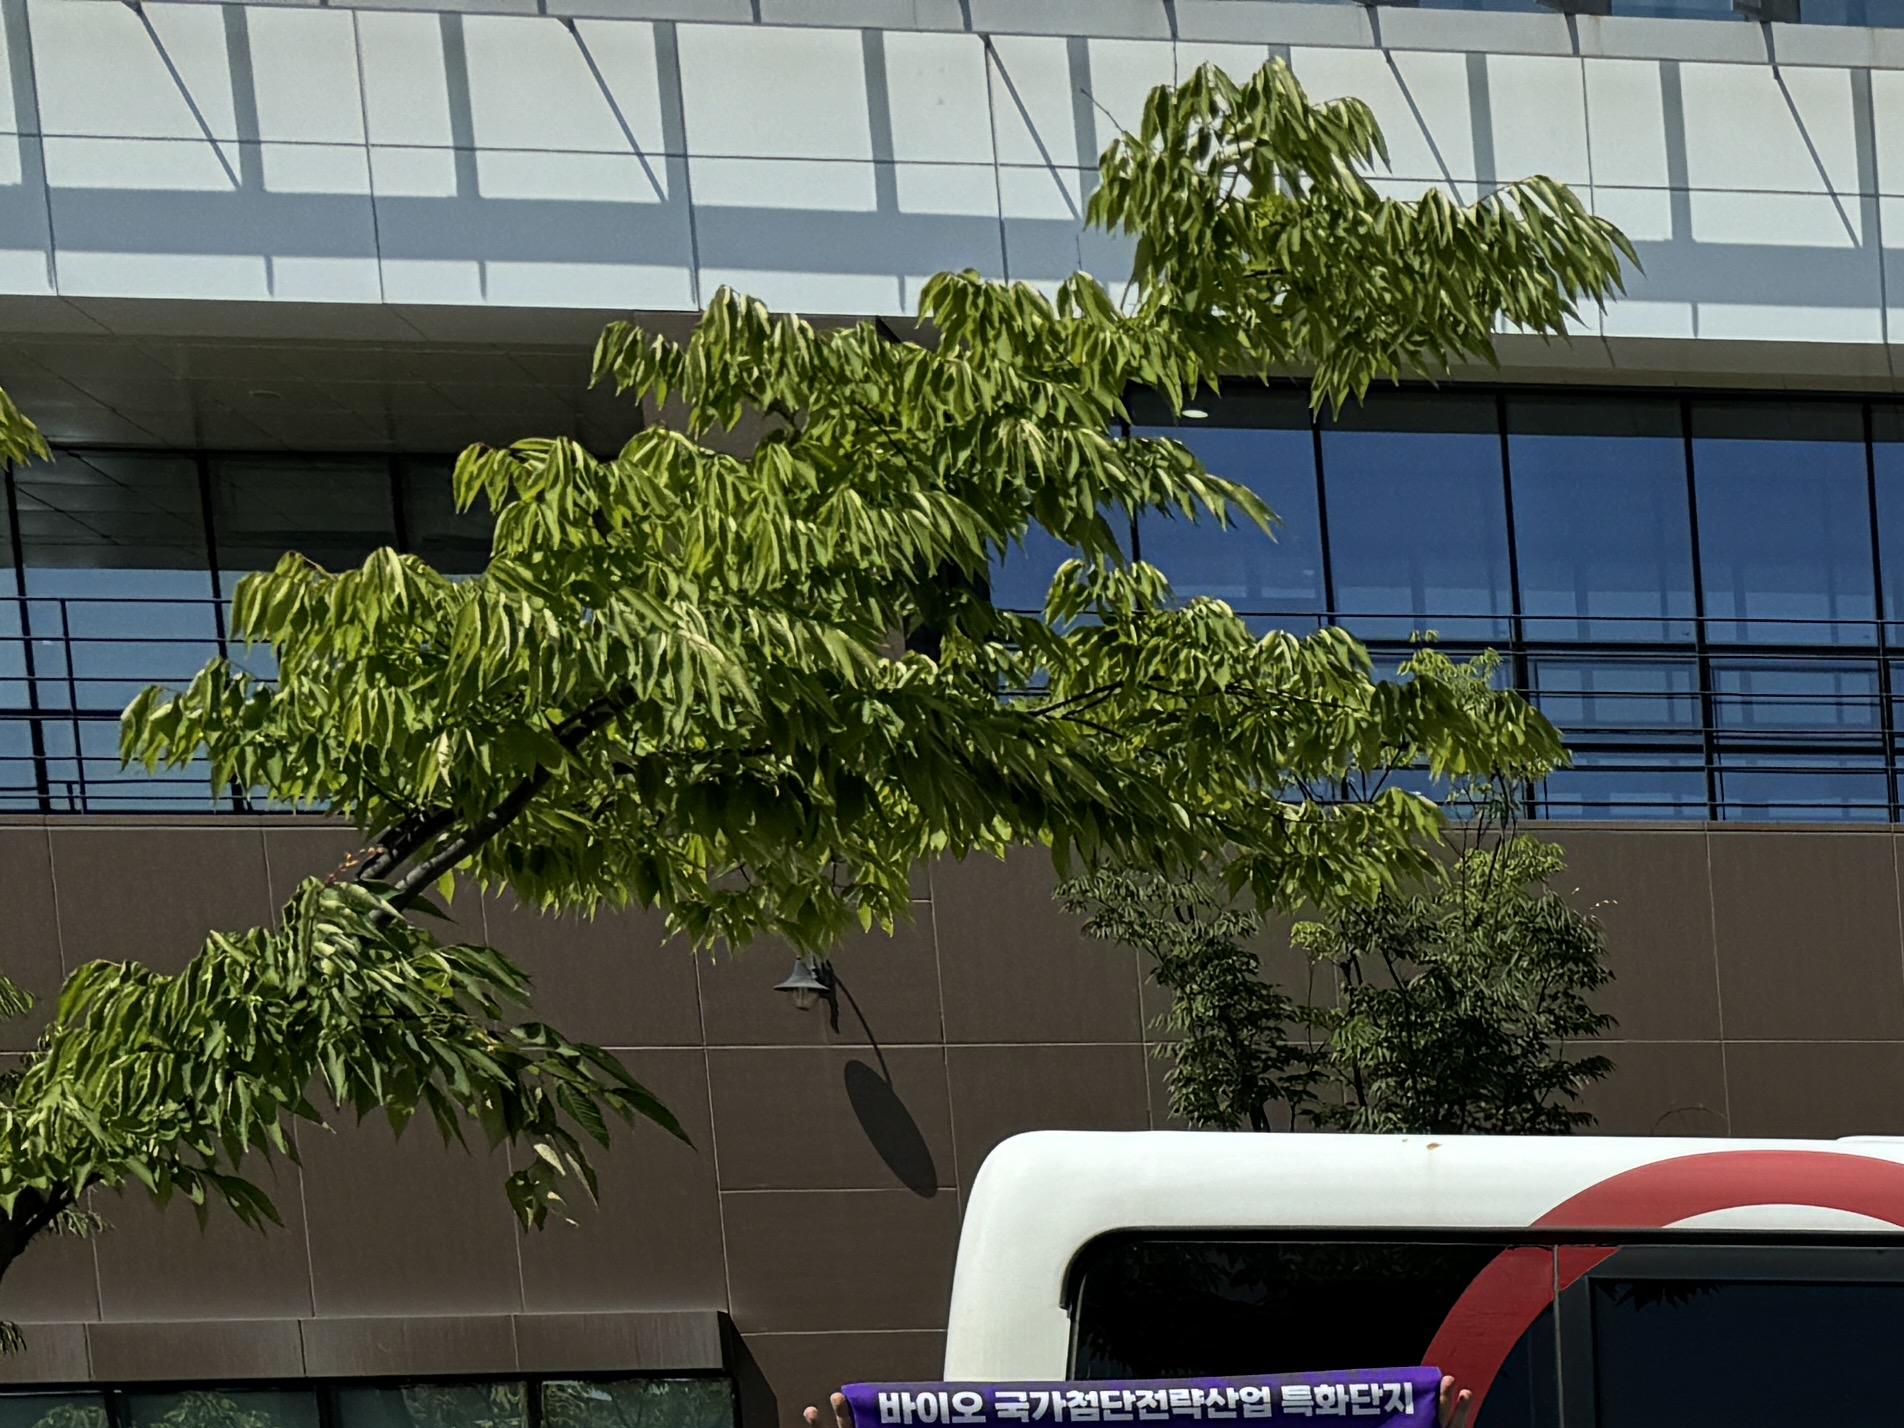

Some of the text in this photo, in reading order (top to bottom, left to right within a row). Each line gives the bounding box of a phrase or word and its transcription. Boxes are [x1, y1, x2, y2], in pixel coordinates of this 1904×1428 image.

[878, 1382, 1414, 1423] 바이오 국가첨단전략산업 특화단지
